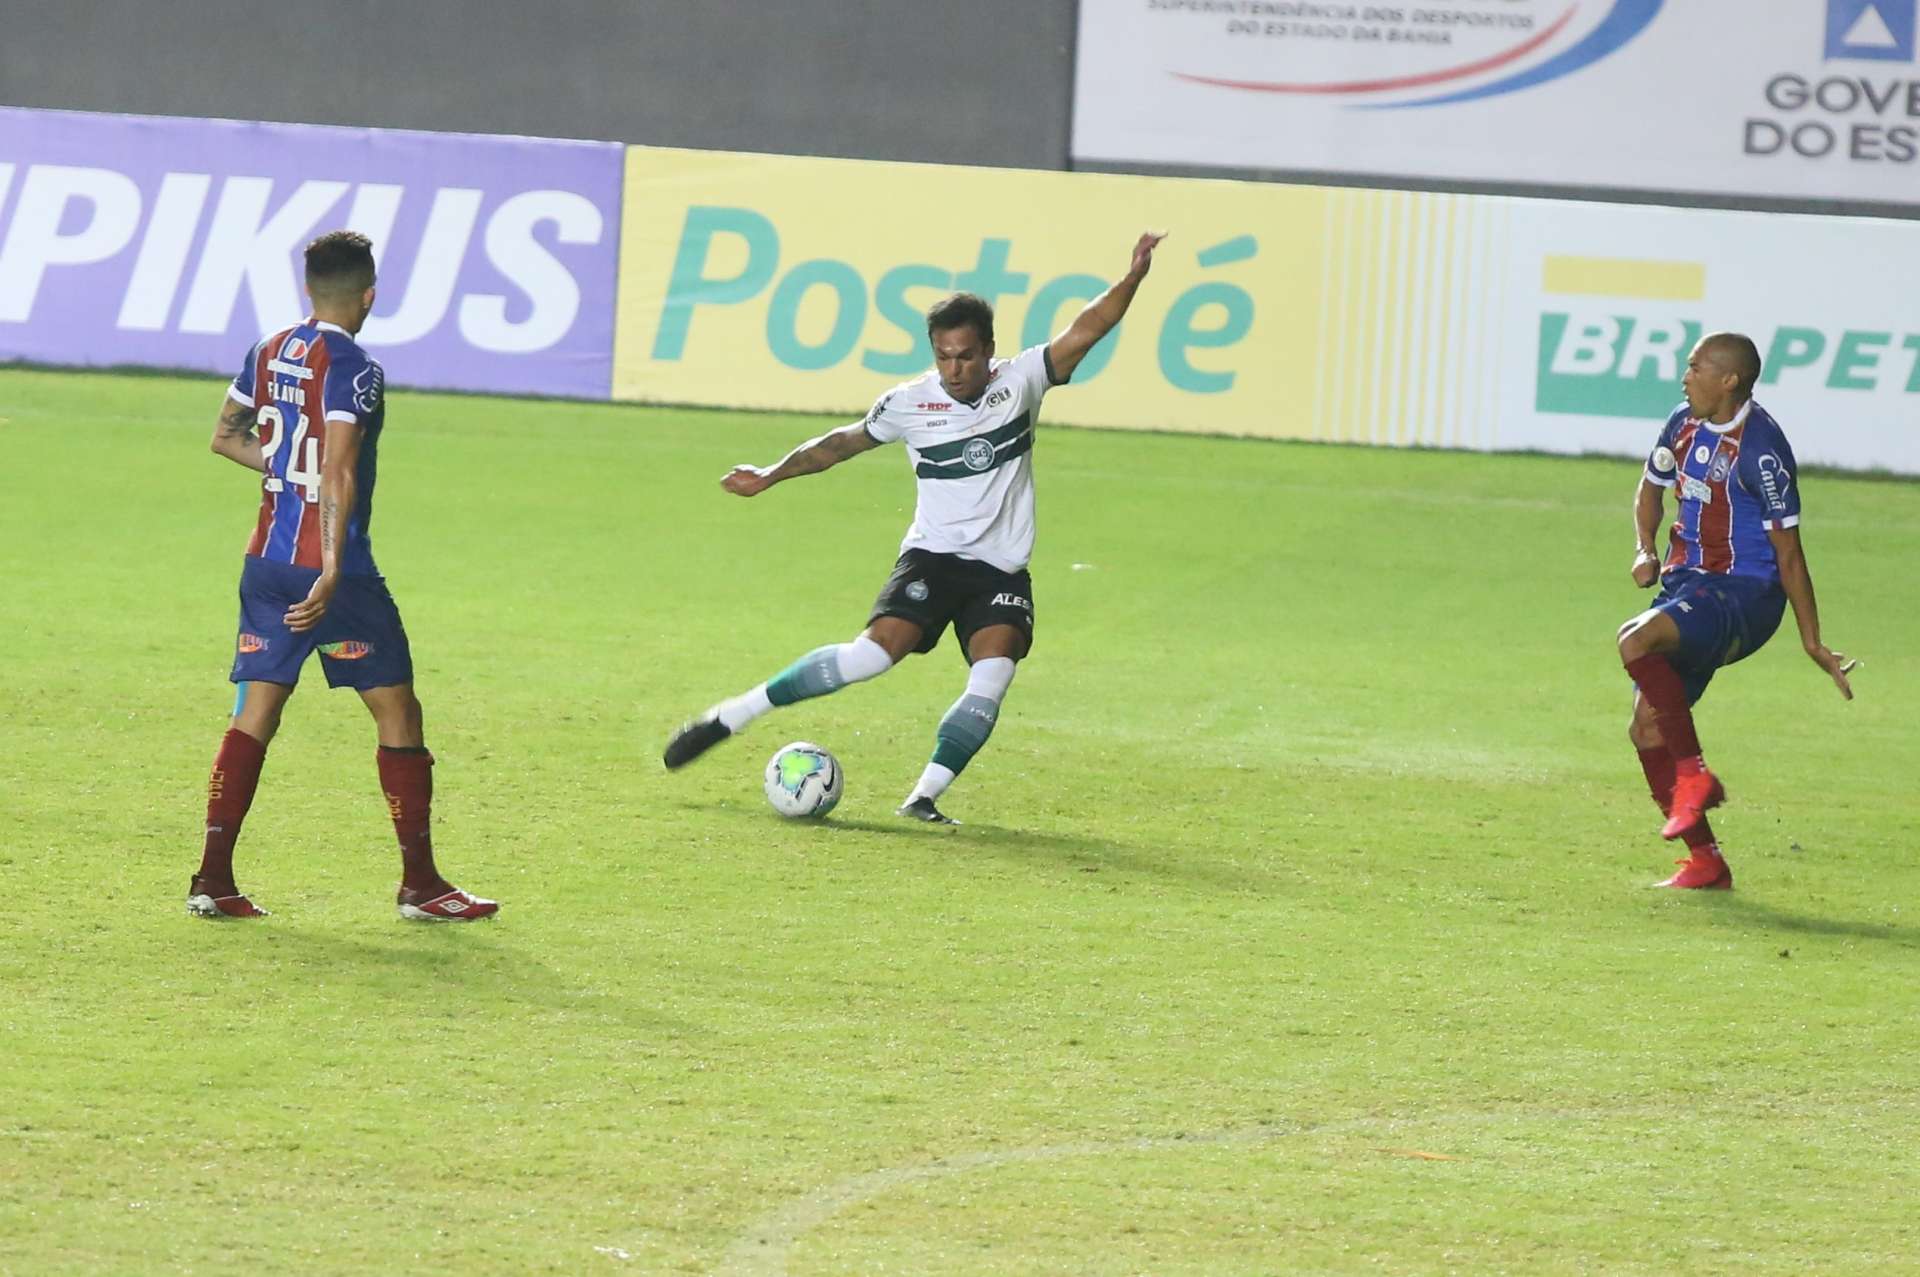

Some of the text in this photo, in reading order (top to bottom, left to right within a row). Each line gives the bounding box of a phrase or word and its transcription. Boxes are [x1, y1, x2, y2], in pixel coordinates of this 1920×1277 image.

[1227, 19, 1452, 45] DO ESTADO DA BAHIA
[1362, 6, 1403, 22] DOS
[1411, 8, 1533, 28] DESPORTOS
[1744, 118, 1919, 163] DO ES
[0, 162, 603, 353] PIKUS
[652, 205, 1260, 394] Posto é
[1550, 313, 1687, 380] BR
[257, 405, 321, 502] 24
